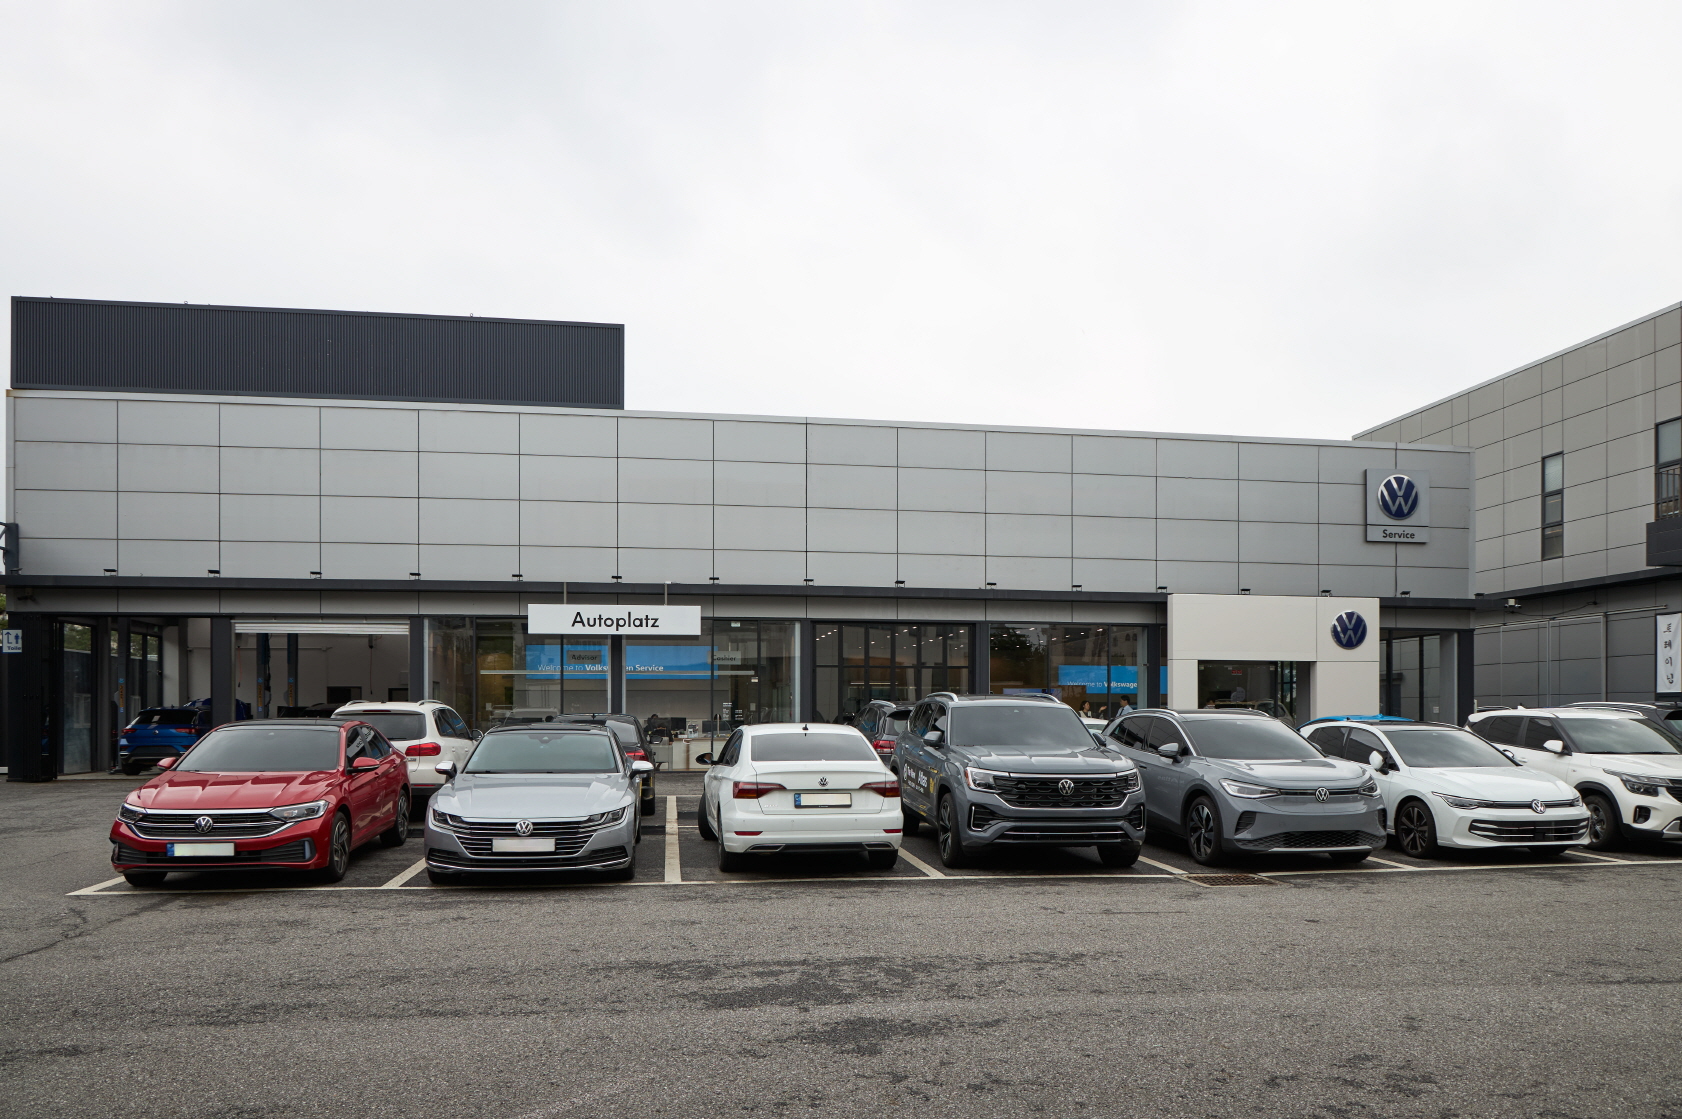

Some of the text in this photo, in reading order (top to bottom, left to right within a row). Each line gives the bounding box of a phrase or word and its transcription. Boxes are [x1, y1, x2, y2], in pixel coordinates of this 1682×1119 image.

[1382, 529, 1416, 539] Service
[571, 611, 660, 631] Autoplatz
[571, 653, 598, 661] Advisor
[1104, 681, 1138, 689] Vlkswage
